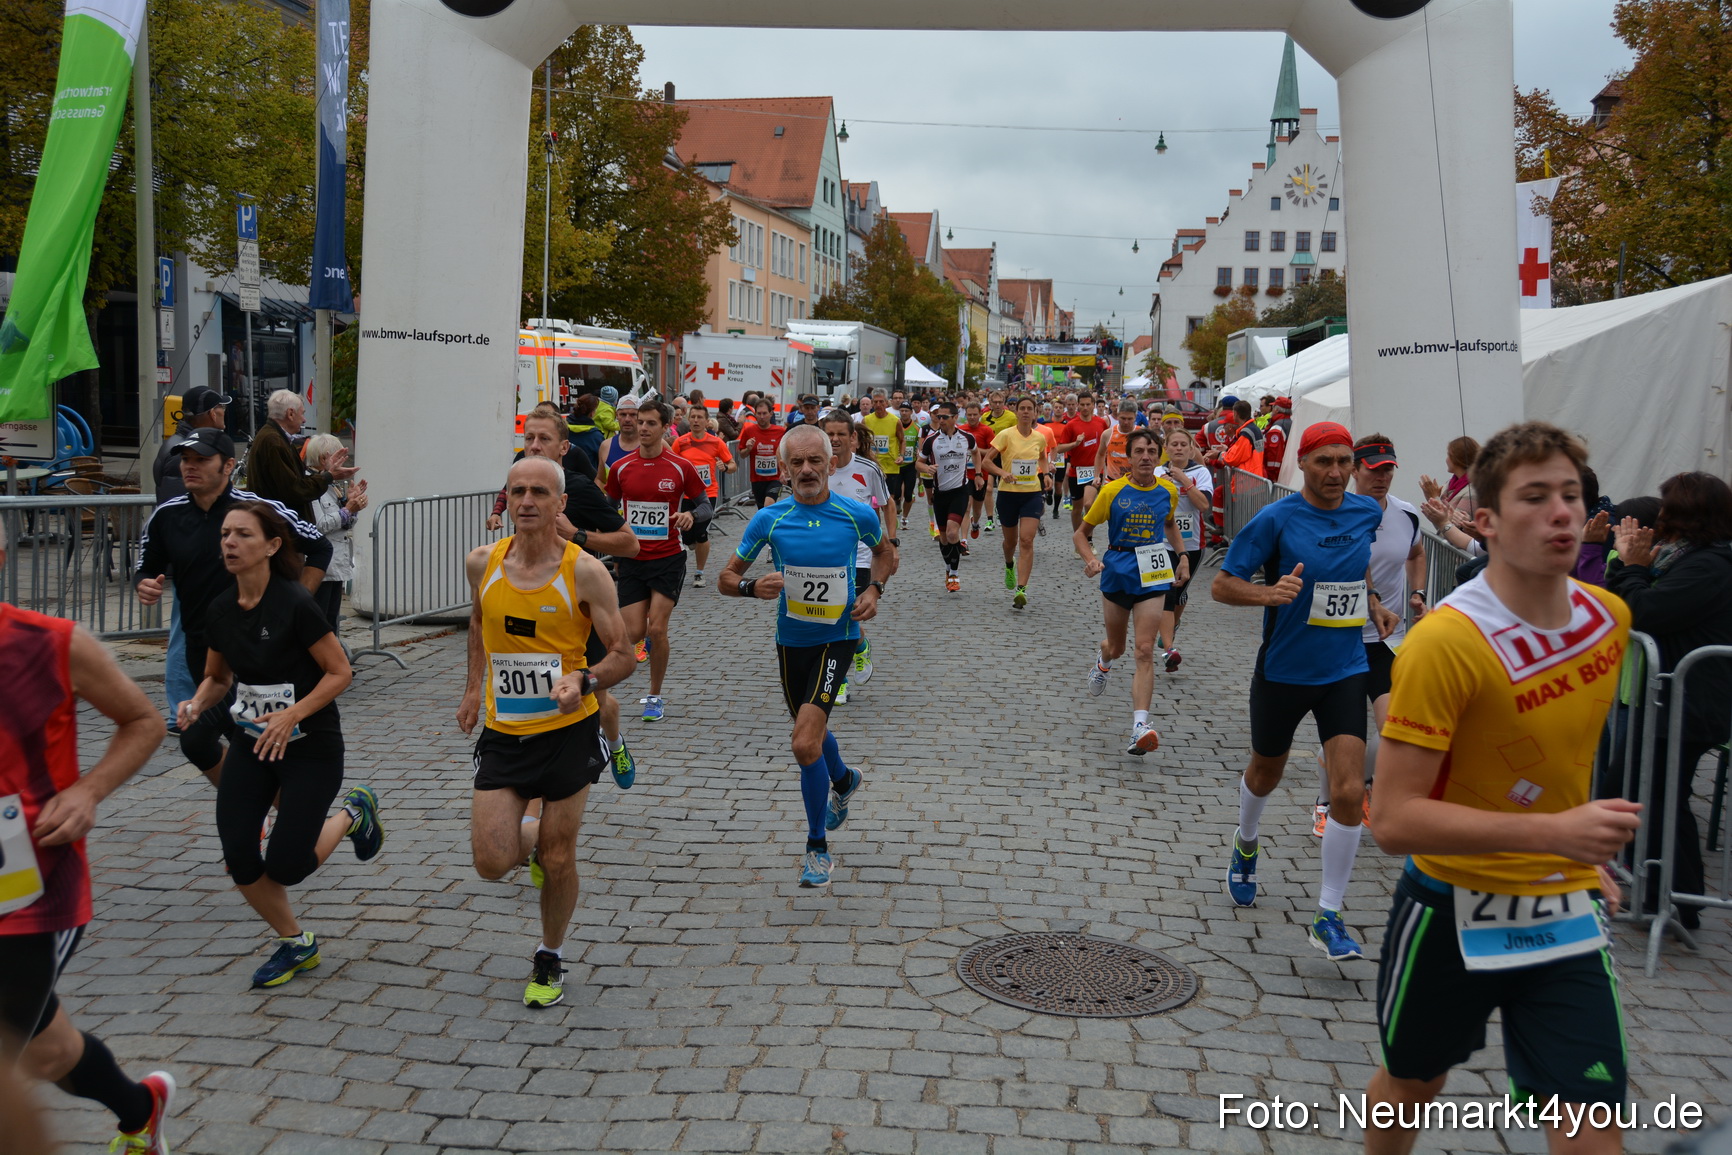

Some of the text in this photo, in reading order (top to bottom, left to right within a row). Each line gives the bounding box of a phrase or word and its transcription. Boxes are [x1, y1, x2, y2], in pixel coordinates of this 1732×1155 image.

[163, 265, 171, 300] P
[194, 325, 200, 340] 3
[361, 327, 490, 346] www.bmw-laufsport.de
[1378, 339, 1518, 357] www.bmw-laufsport.de
[728, 362, 761, 370] Bayerisches
[0, 423, 38, 432] erngasse
[757, 461, 776, 469] 2676
[1020, 465, 1030, 475] 34
[1080, 470, 1096, 478] 233
[631, 511, 665, 525] 2762
[1151, 553, 1166, 569] 59
[786, 570, 805, 578] PARTL
[803, 581, 829, 602] 22
[806, 606, 826, 616] Willi
[1326, 594, 1360, 616] 537
[499, 670, 554, 695] 3011
[824, 658, 837, 695] SKINS
[1514, 673, 1576, 714] MAX
[1503, 931, 1557, 950] Jonas
